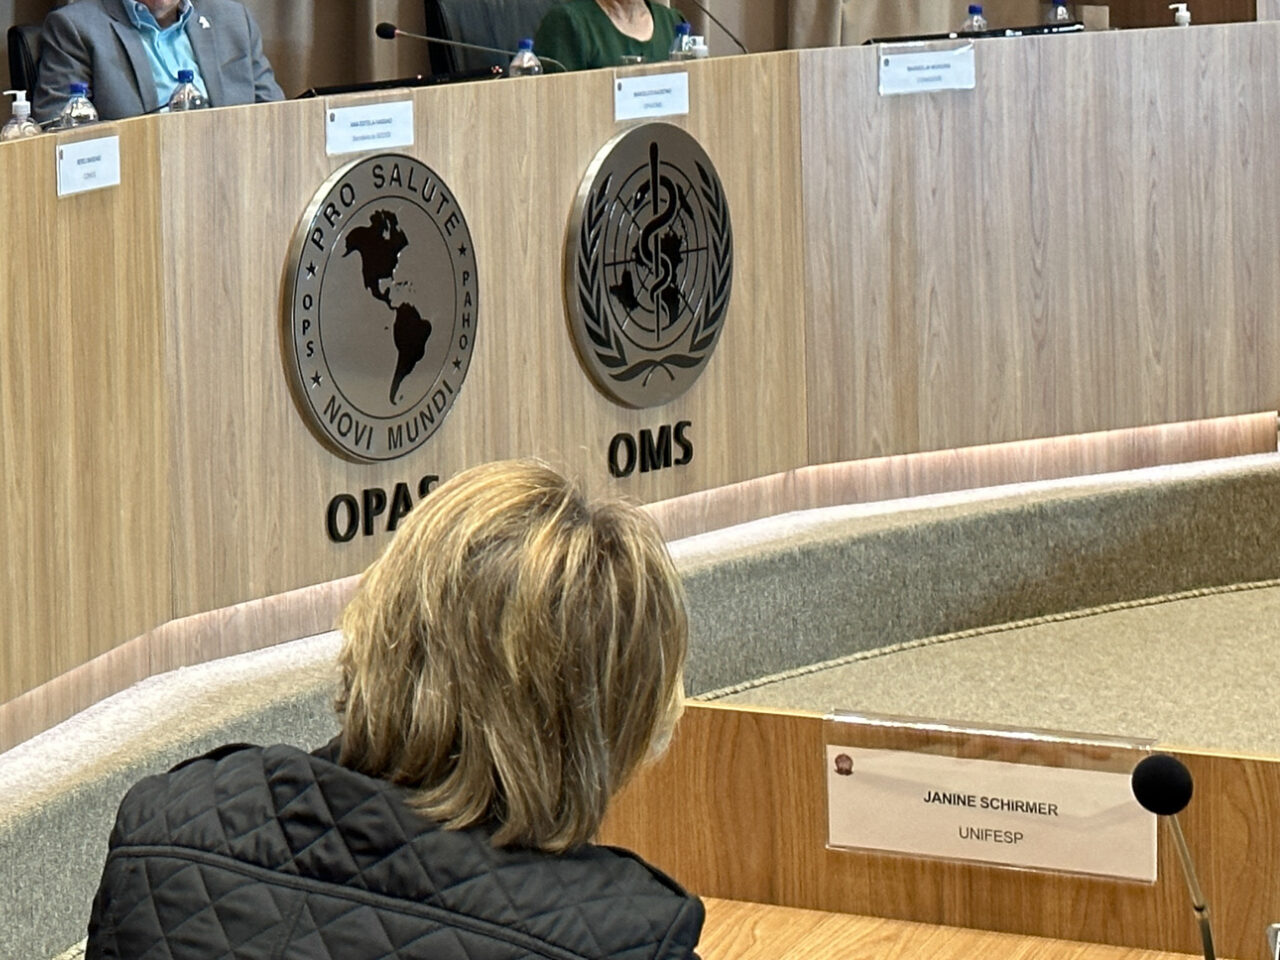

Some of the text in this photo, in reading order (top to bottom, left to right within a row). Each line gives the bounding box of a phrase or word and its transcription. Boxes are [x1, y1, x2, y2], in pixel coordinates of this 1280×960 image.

[310, 163, 460, 252] PRO SALUTE
[302, 293, 314, 358] OPS
[458, 270, 472, 350] PAHO
[323, 379, 454, 451] NOVI MUNDI
[608, 420, 694, 478] OMS
[923, 790, 1059, 817] JANINE SCHIRMER
[958, 826, 1024, 845] UNIFESP
